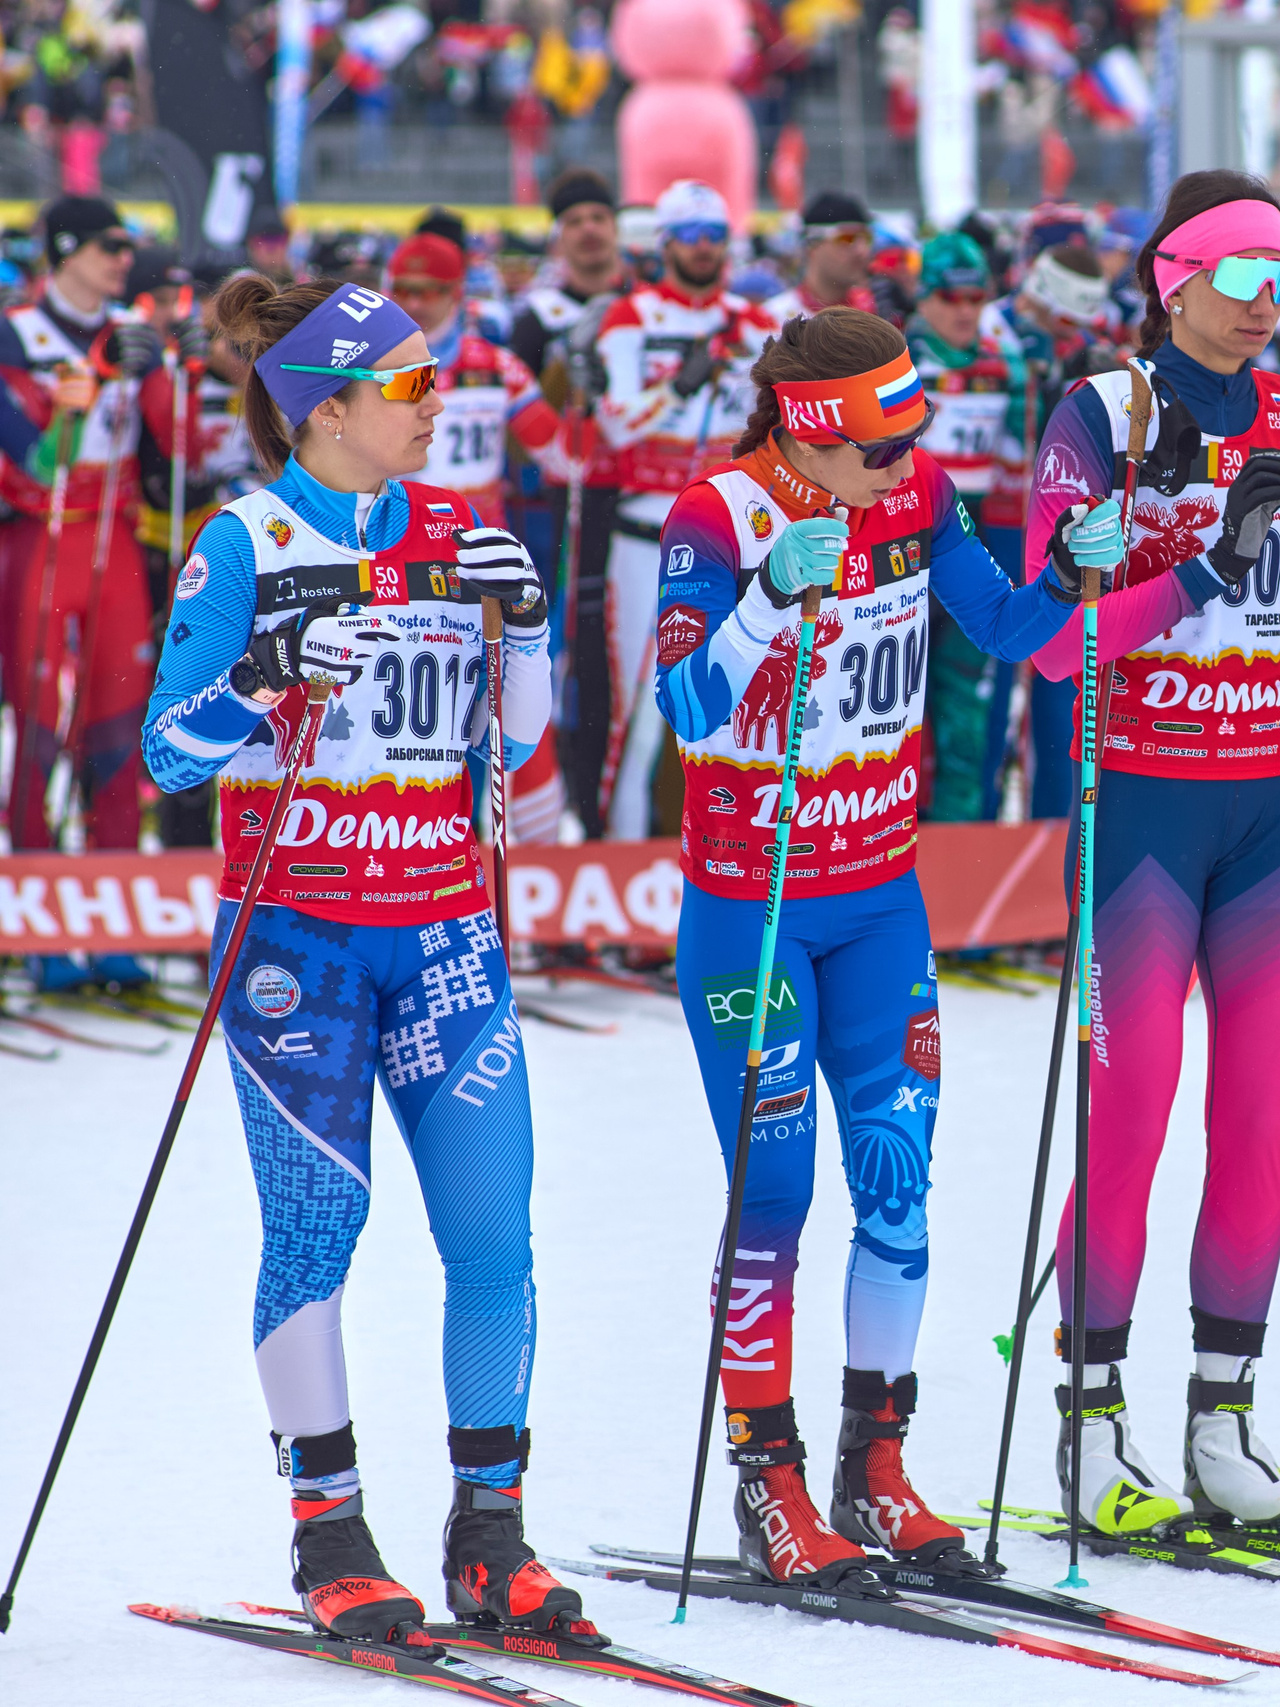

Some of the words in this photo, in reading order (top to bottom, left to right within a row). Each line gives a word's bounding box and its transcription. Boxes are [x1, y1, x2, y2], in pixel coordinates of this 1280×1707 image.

[1223, 449, 1243, 468] 50
[848, 553, 868, 575] 50
[375, 567, 399, 584] 50
[847, 574, 867, 591] KM
[300, 586, 342, 598] Rostec
[376, 585, 400, 599] KM
[668, 588, 700, 597] СПОРТ
[669, 581, 711, 590] ЮВЕНТА
[853, 602, 893, 620] Rostec
[387, 613, 432, 629] Rostec
[276, 637, 294, 679] SWIX
[371, 651, 482, 741] 3012
[1155, 722, 1201, 733] POWERUP
[1112, 735, 1127, 744] МОЙ
[1112, 742, 1136, 751] СПОРТ
[385, 746, 444, 762] ЗАБОРСКАЯ
[1157, 746, 1208, 758] MADSHUS
[1217, 744, 1279, 758] MOAXSPORT
[701, 834, 748, 851] BIVIUM
[290, 866, 345, 875] POWERUP
[721, 861, 737, 870] МОЙ
[828, 852, 885, 876] MOAXSPORT
[721, 868, 746, 878] СПОРТ
[294, 891, 351, 900] MADSHUS
[361, 890, 430, 903] MOAXSPORT
[750, 1114, 815, 1144] MOAX
[514, 1344, 530, 1395] CODE
[738, 1453, 770, 1462] alpina
[1129, 1545, 1177, 1562] FISCHER
[895, 1569, 935, 1587] ATOMIC
[801, 1592, 838, 1609] ATOMIC
[503, 1635, 561, 1660] ROSSIGNOL
[351, 1648, 398, 1673] ROSSIGNOL
